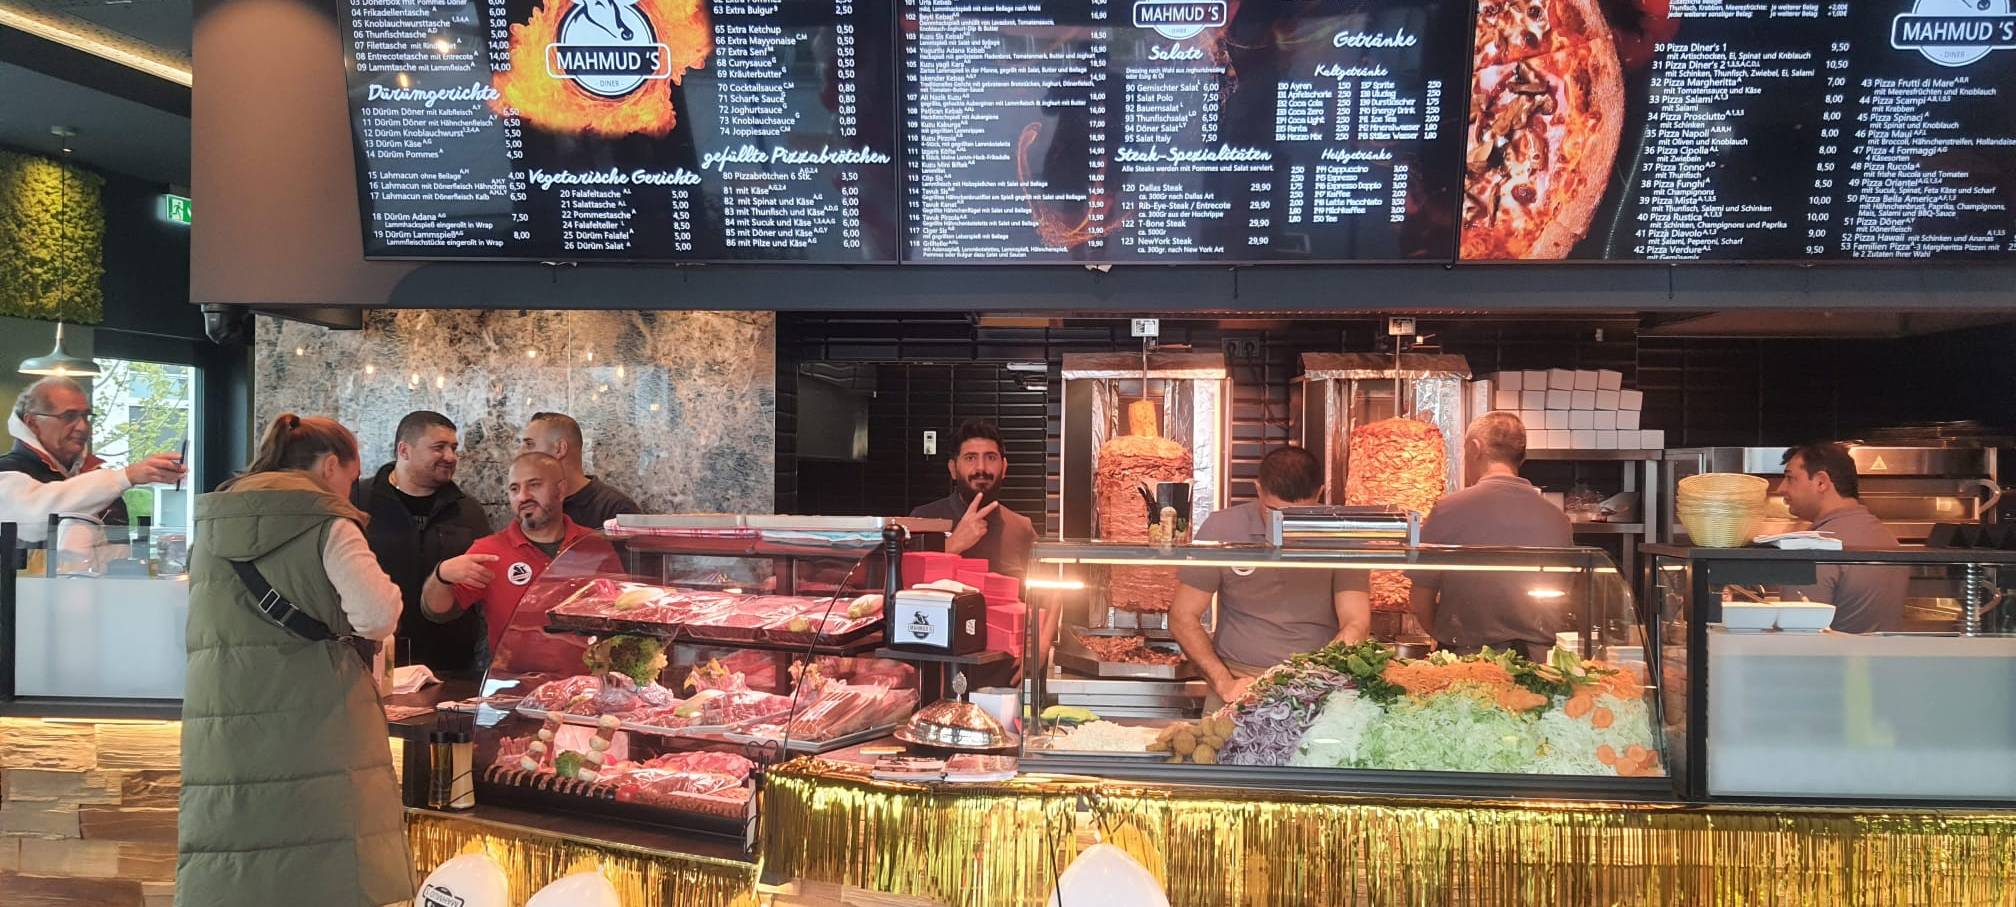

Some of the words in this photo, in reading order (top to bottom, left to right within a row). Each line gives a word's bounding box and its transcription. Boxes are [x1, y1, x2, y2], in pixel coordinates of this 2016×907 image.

[363, 7, 430, 16] Frikadellentasche
[489, 8, 506, 17] 6,00
[713, 6, 723, 14] 63
[726, 5, 745, 14] Extra
[836, 5, 853, 15] 2,50
[1142, 7, 1204, 21] MAHMUD
[352, 19, 362, 27] 05
[364, 19, 450, 28] Knoblauchwursttasche
[715, 25, 725, 33] 65
[727, 25, 747, 34] Extra
[749, 25, 781, 36] Ketchup
[837, 25, 854, 35] 0,50
[1903, 22, 1993, 40] MAHMUD
[1333, 28, 1416, 48] Getränke
[367, 41, 407, 49] Filettasche
[1654, 43, 1665, 52] 30
[1667, 43, 1688, 52] Pizza
[1723, 43, 1726, 51] 1
[1832, 42, 1850, 52] 9,50
[1148, 43, 1203, 60] Salate
[1667, 53, 1679, 61] mit
[1738, 52, 1761, 61] Spinat
[556, 51, 641, 71] MAHMUD
[1665, 61, 1689, 70] Pizza
[1826, 60, 1848, 69] 10,50
[369, 63, 417, 72] Lammtasche
[1314, 64, 1388, 79] Kaltgetränke
[717, 70, 727, 78] 69
[838, 69, 855, 79] 0,50
[1126, 84, 1135, 92] 90
[1137, 83, 1179, 92] Gemischter
[1203, 83, 1219, 92] 6,00
[1861, 79, 1872, 87] 43
[1874, 79, 1896, 88] Pizza
[1898, 79, 1920, 88] Frutti
[1922, 79, 1931, 88] di
[367, 81, 501, 108] Dürümgerichte
[1137, 93, 1155, 102] Salat
[1157, 94, 1173, 102] Polo
[1203, 93, 1219, 103] 7,50
[1662, 95, 1685, 105] Pizza
[1825, 94, 1843, 104] 8,00
[362, 108, 371, 116] 10
[401, 107, 424, 115] Döner
[426, 107, 437, 115] mit
[1137, 104, 1179, 112] Bauernsalat
[1202, 103, 1218, 112] 6,00
[375, 118, 401, 126] Dürüm
[403, 118, 426, 126] Döner
[504, 118, 520, 127] 6,50
[1870, 113, 1891, 122] Pizza
[1658, 128, 1681, 139] Pizza
[1682, 128, 1709, 138] Napoli
[1821, 129, 1839, 138] 8,00
[1125, 134, 1134, 142] 95
[1136, 134, 1154, 142] Salat
[1155, 134, 1171, 145] Italy
[1201, 133, 1217, 143] 7,50
[702, 145, 769, 170] gefüllte
[771, 145, 890, 164] Pizzabrötchen
[1114, 143, 1272, 167] Steak-Spezialitäten
[1321, 148, 1392, 163] Heißgetränke
[368, 171, 377, 179] 15
[380, 171, 419, 179] Lahmacun
[508, 172, 525, 180] 4,00
[529, 168, 630, 190] Vegetarische
[631, 169, 702, 185] Gerichte
[735, 171, 789, 180] Pizzabrötchen
[842, 172, 858, 181] 3,50
[1122, 184, 1135, 192] 120
[1163, 183, 1183, 191] Steak
[1250, 183, 1271, 192] 29,90
[1641, 180, 1652, 188] 38
[1653, 180, 1674, 189] Pizza
[1815, 179, 1832, 188] 8,50
[572, 190, 621, 198] Falafeltasche
[672, 190, 688, 199] 5,00
[1860, 194, 1882, 204] Pizza
[1881, 194, 1904, 203] Bella
[572, 200, 616, 208] Salattasche
[672, 200, 689, 210] 5,00
[724, 197, 734, 205] 82
[738, 197, 751, 205] mit
[751, 197, 776, 208] Spinat
[776, 197, 794, 205] und
[842, 197, 859, 207] 6,00
[1139, 201, 1191, 212] Rib-Eye-Steak
[1196, 201, 1231, 209] Entrecote
[1250, 201, 1270, 210] 29,90
[412, 213, 436, 221] Adana
[512, 213, 528, 222] 7,50
[737, 218, 750, 226] mit
[774, 218, 792, 226] und
[794, 218, 812, 226] Käse
[843, 217, 859, 228] 6,00
[673, 222, 690, 231] 8,50
[1121, 219, 1134, 227] 122
[1138, 219, 1164, 228] T-Bone
[1164, 219, 1186, 227] Steak
[1249, 219, 1269, 228] 29,90
[1121, 237, 1134, 245] 123
[1172, 237, 1192, 245] Steak
[1248, 237, 1269, 245] 29,90
[1842, 233, 1852, 242] 52
[1854, 233, 1877, 243] Pizza
[1876, 233, 1905, 243] Hawaii
